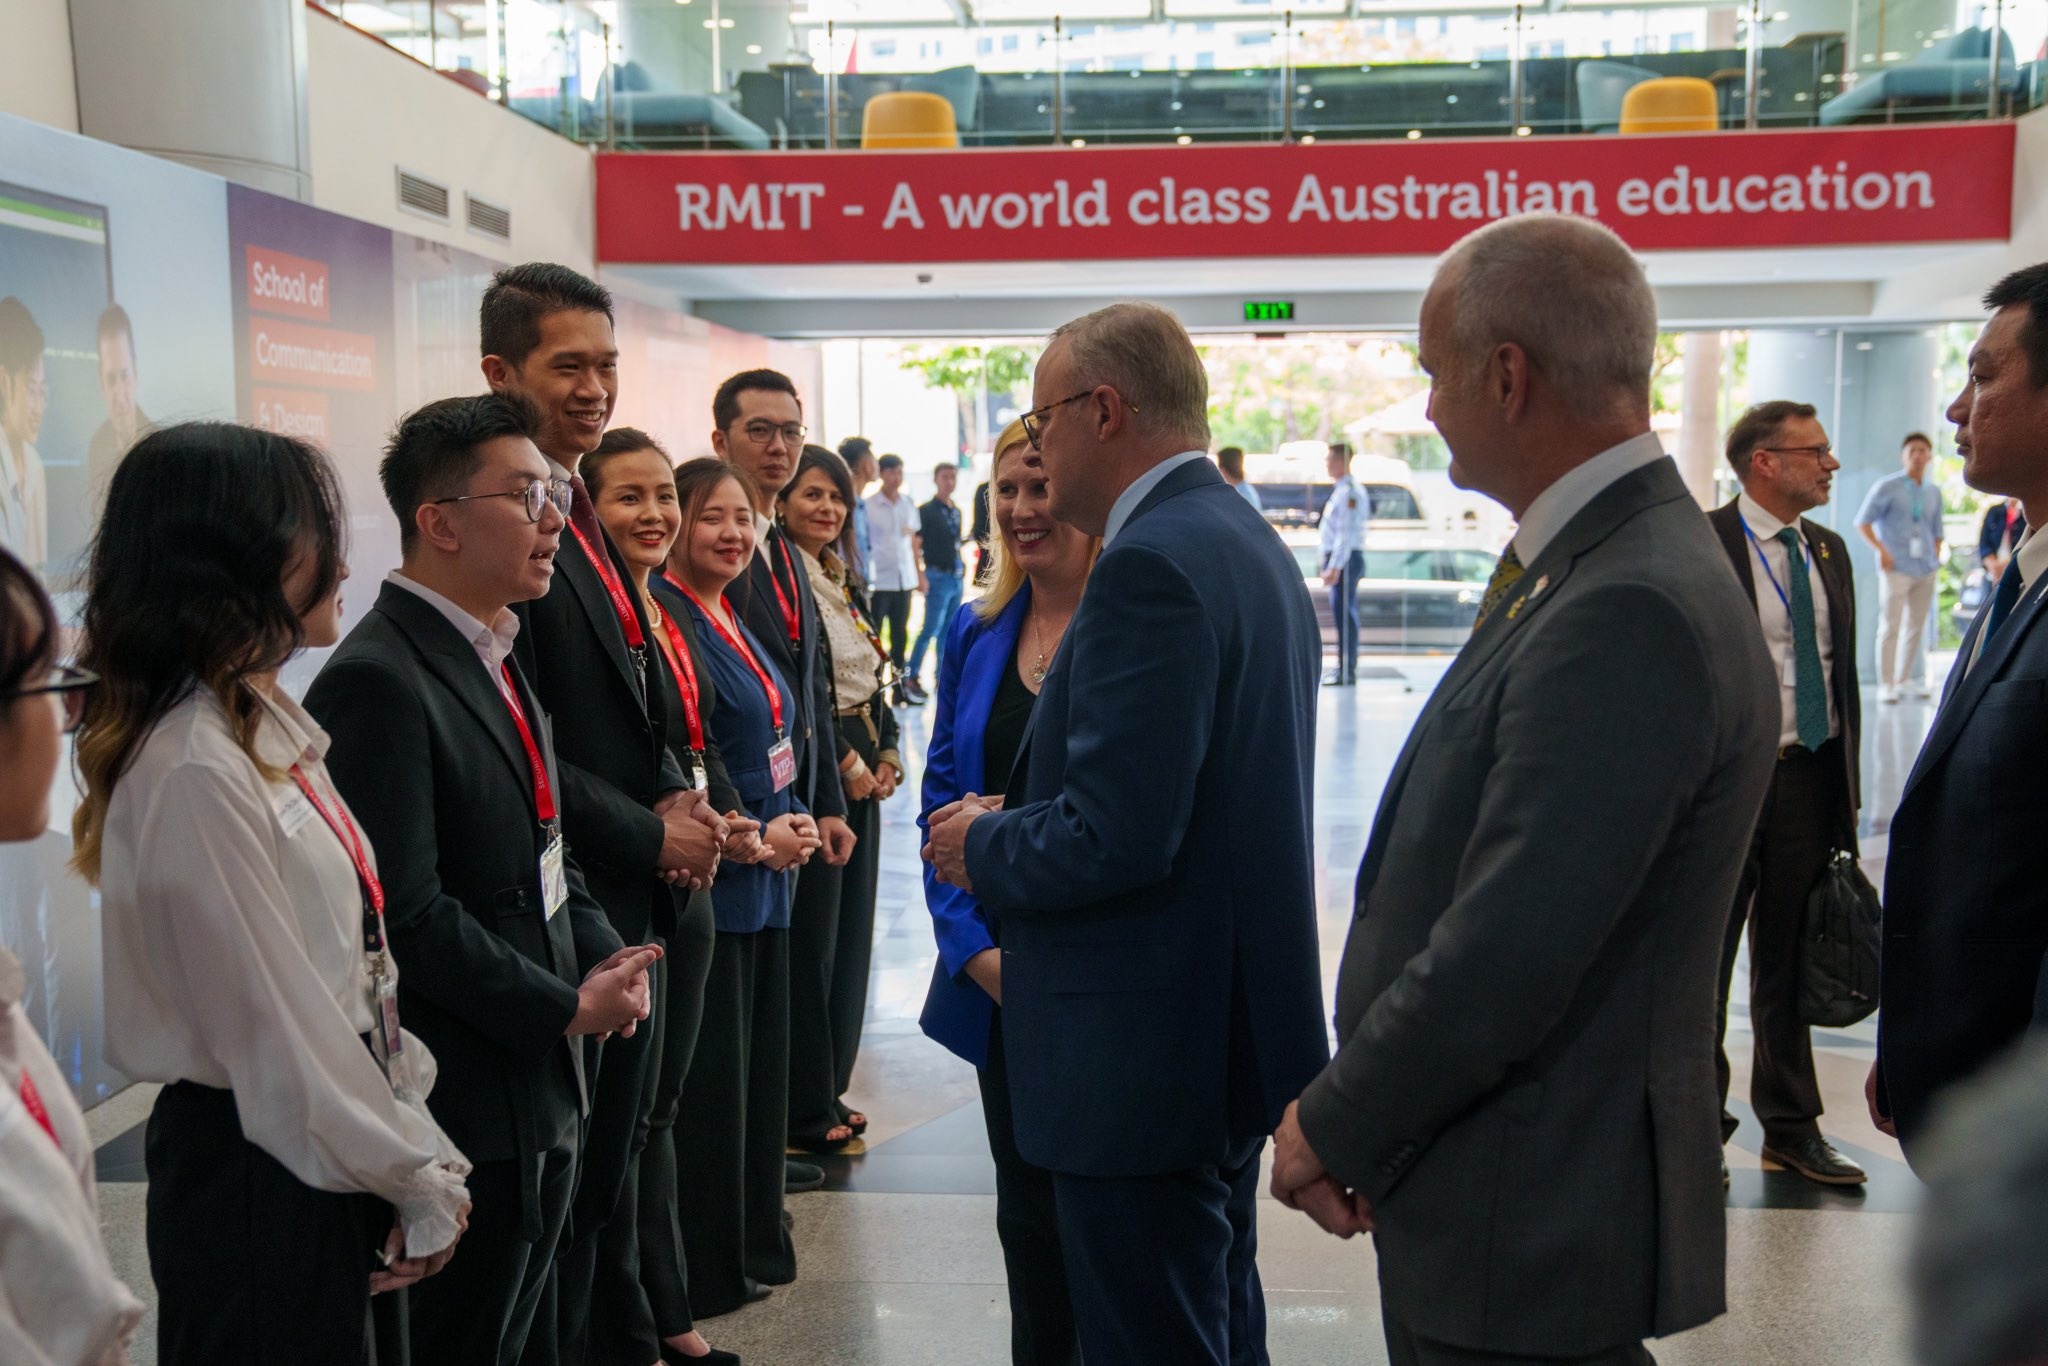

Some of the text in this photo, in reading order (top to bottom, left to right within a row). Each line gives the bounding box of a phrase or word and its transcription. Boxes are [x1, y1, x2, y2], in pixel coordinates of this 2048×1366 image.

[676, 161, 1935, 230] RMIT - A world class Australian education
[253, 261, 325, 307] School of
[1245, 302, 1290, 320] EXIT
[255, 332, 372, 377] Communication
[258, 402, 324, 438] & Design
[611, 590, 631, 621] SECURITY
[686, 698, 697, 728] SECURITY
